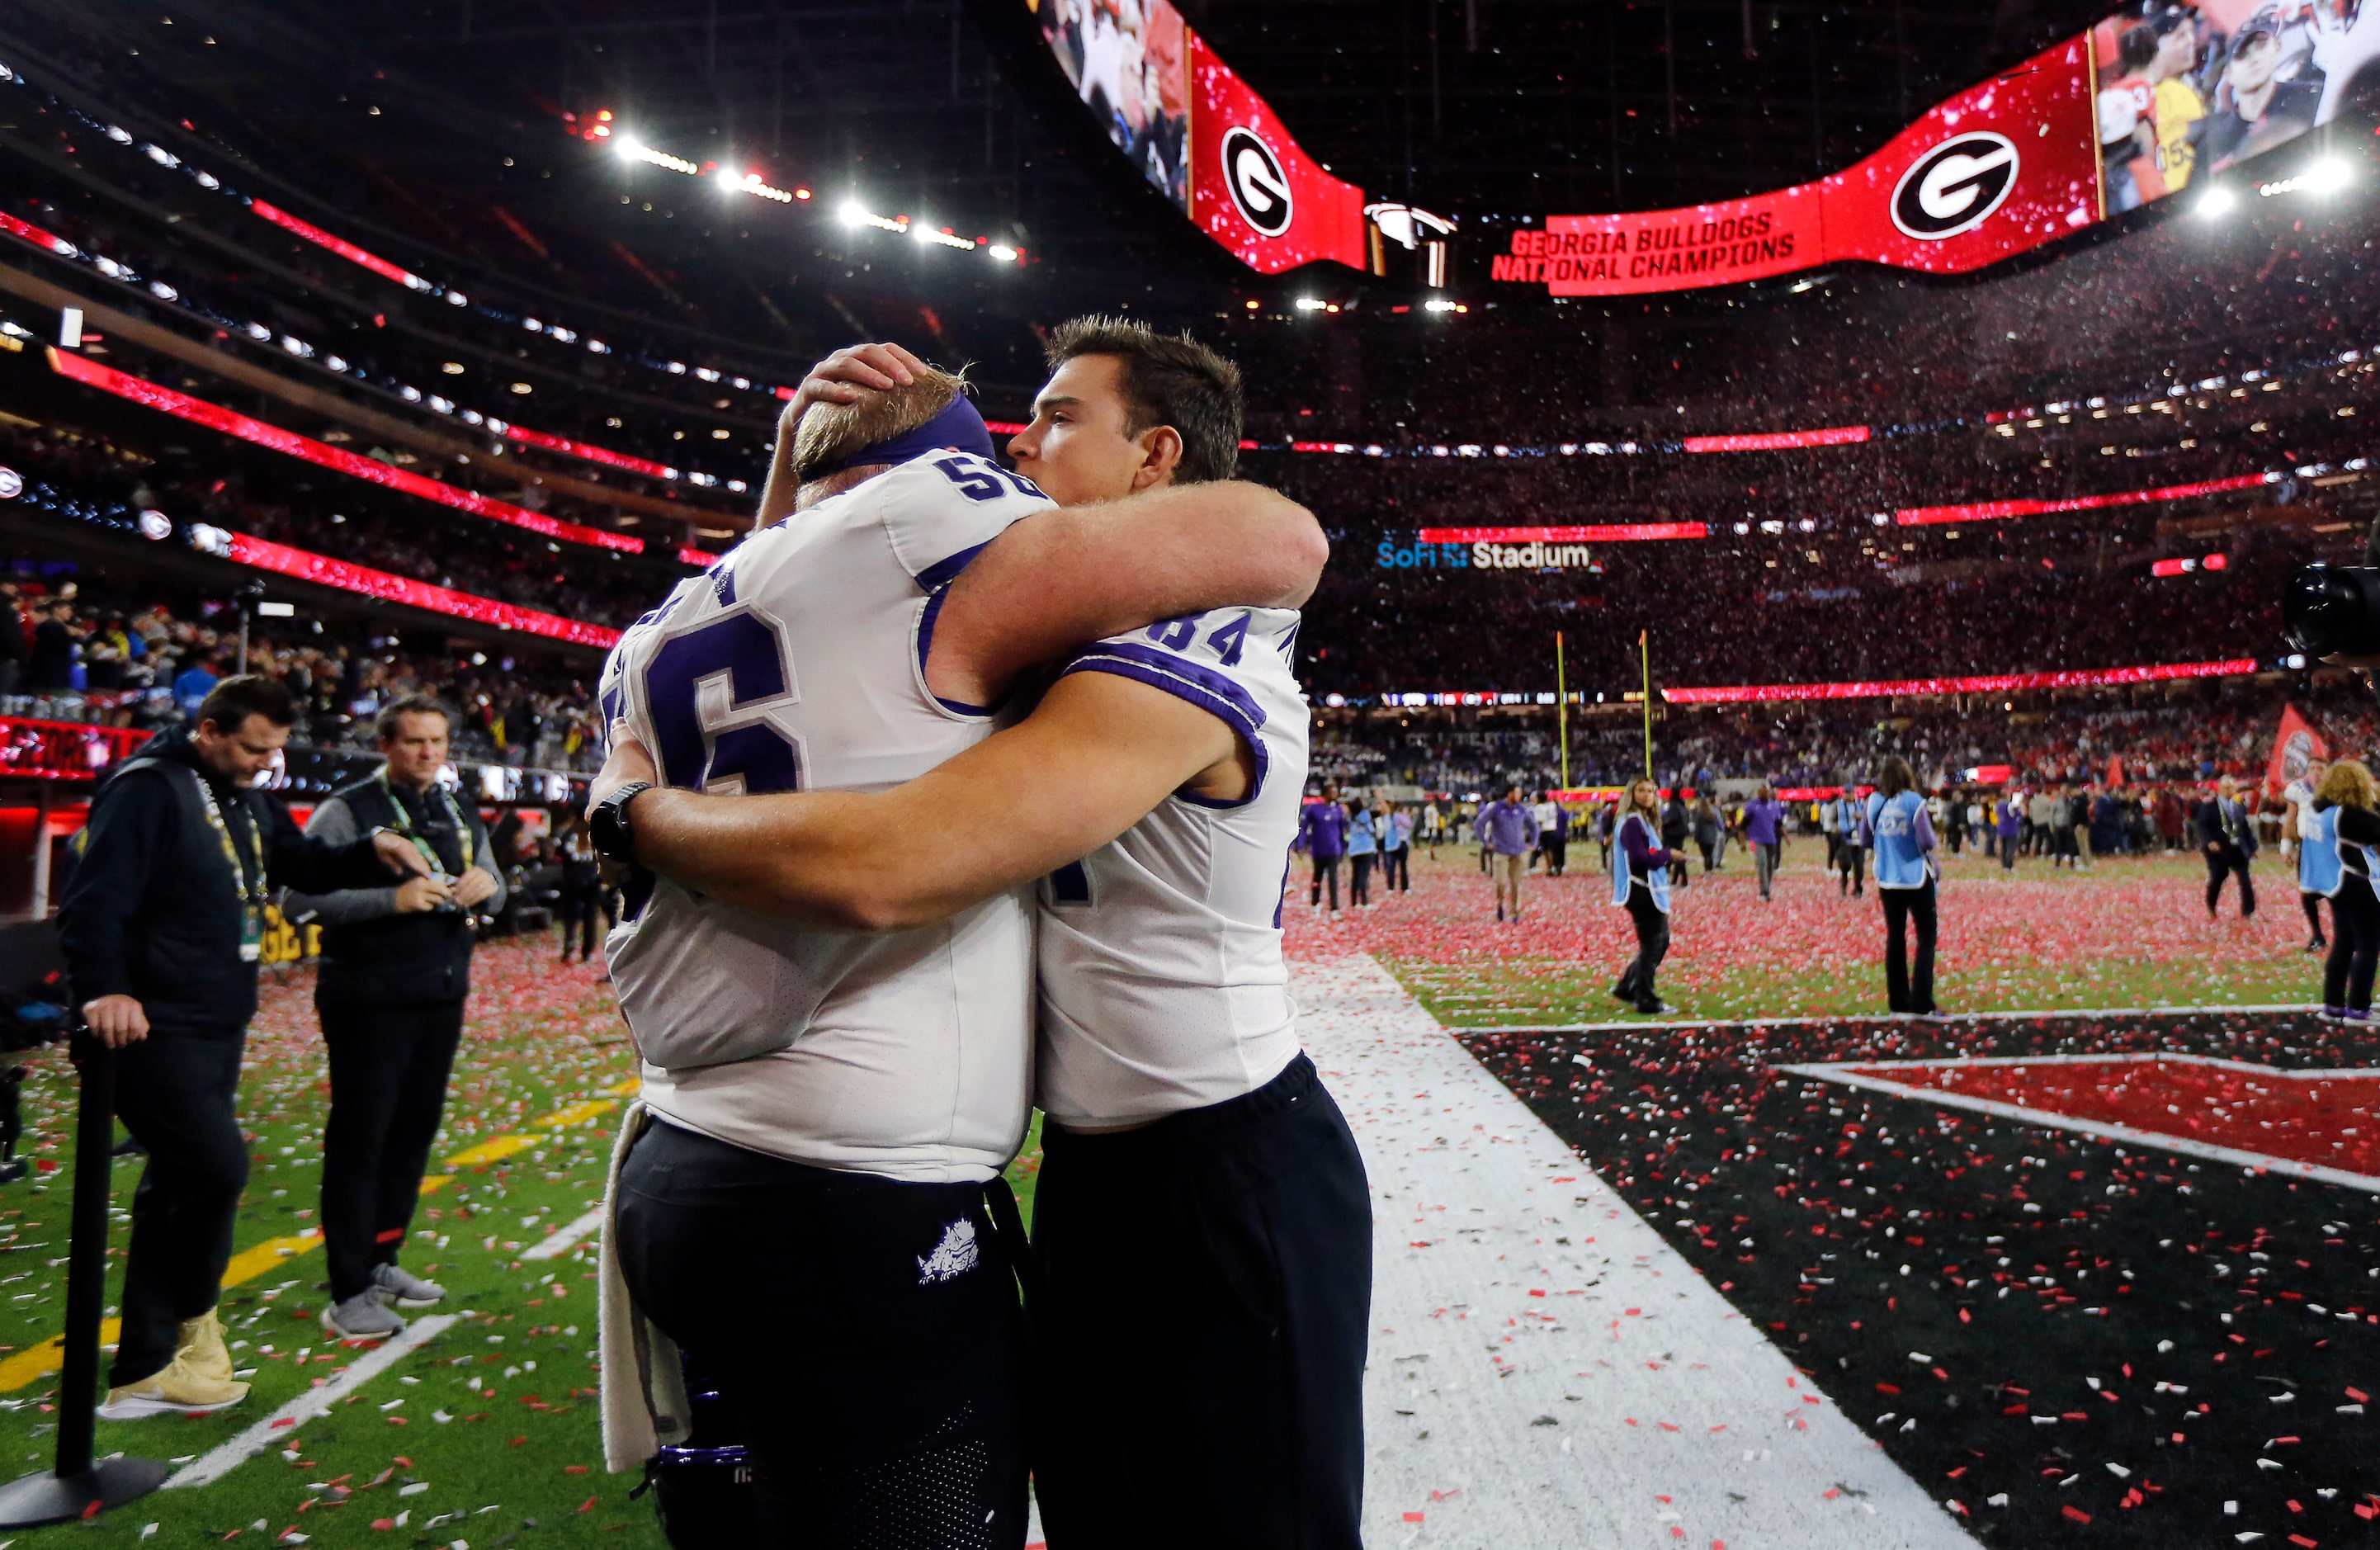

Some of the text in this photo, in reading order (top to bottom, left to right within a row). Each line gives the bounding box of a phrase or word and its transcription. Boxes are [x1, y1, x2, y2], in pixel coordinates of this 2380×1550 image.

[1491, 233, 1795, 283] NATIONAL CHAMPIONS
[1511, 212, 1772, 258] GEORGIA BULLDOGS
[1377, 541, 1590, 569] SoFi Stadium
[12, 723, 121, 773] GEOR
